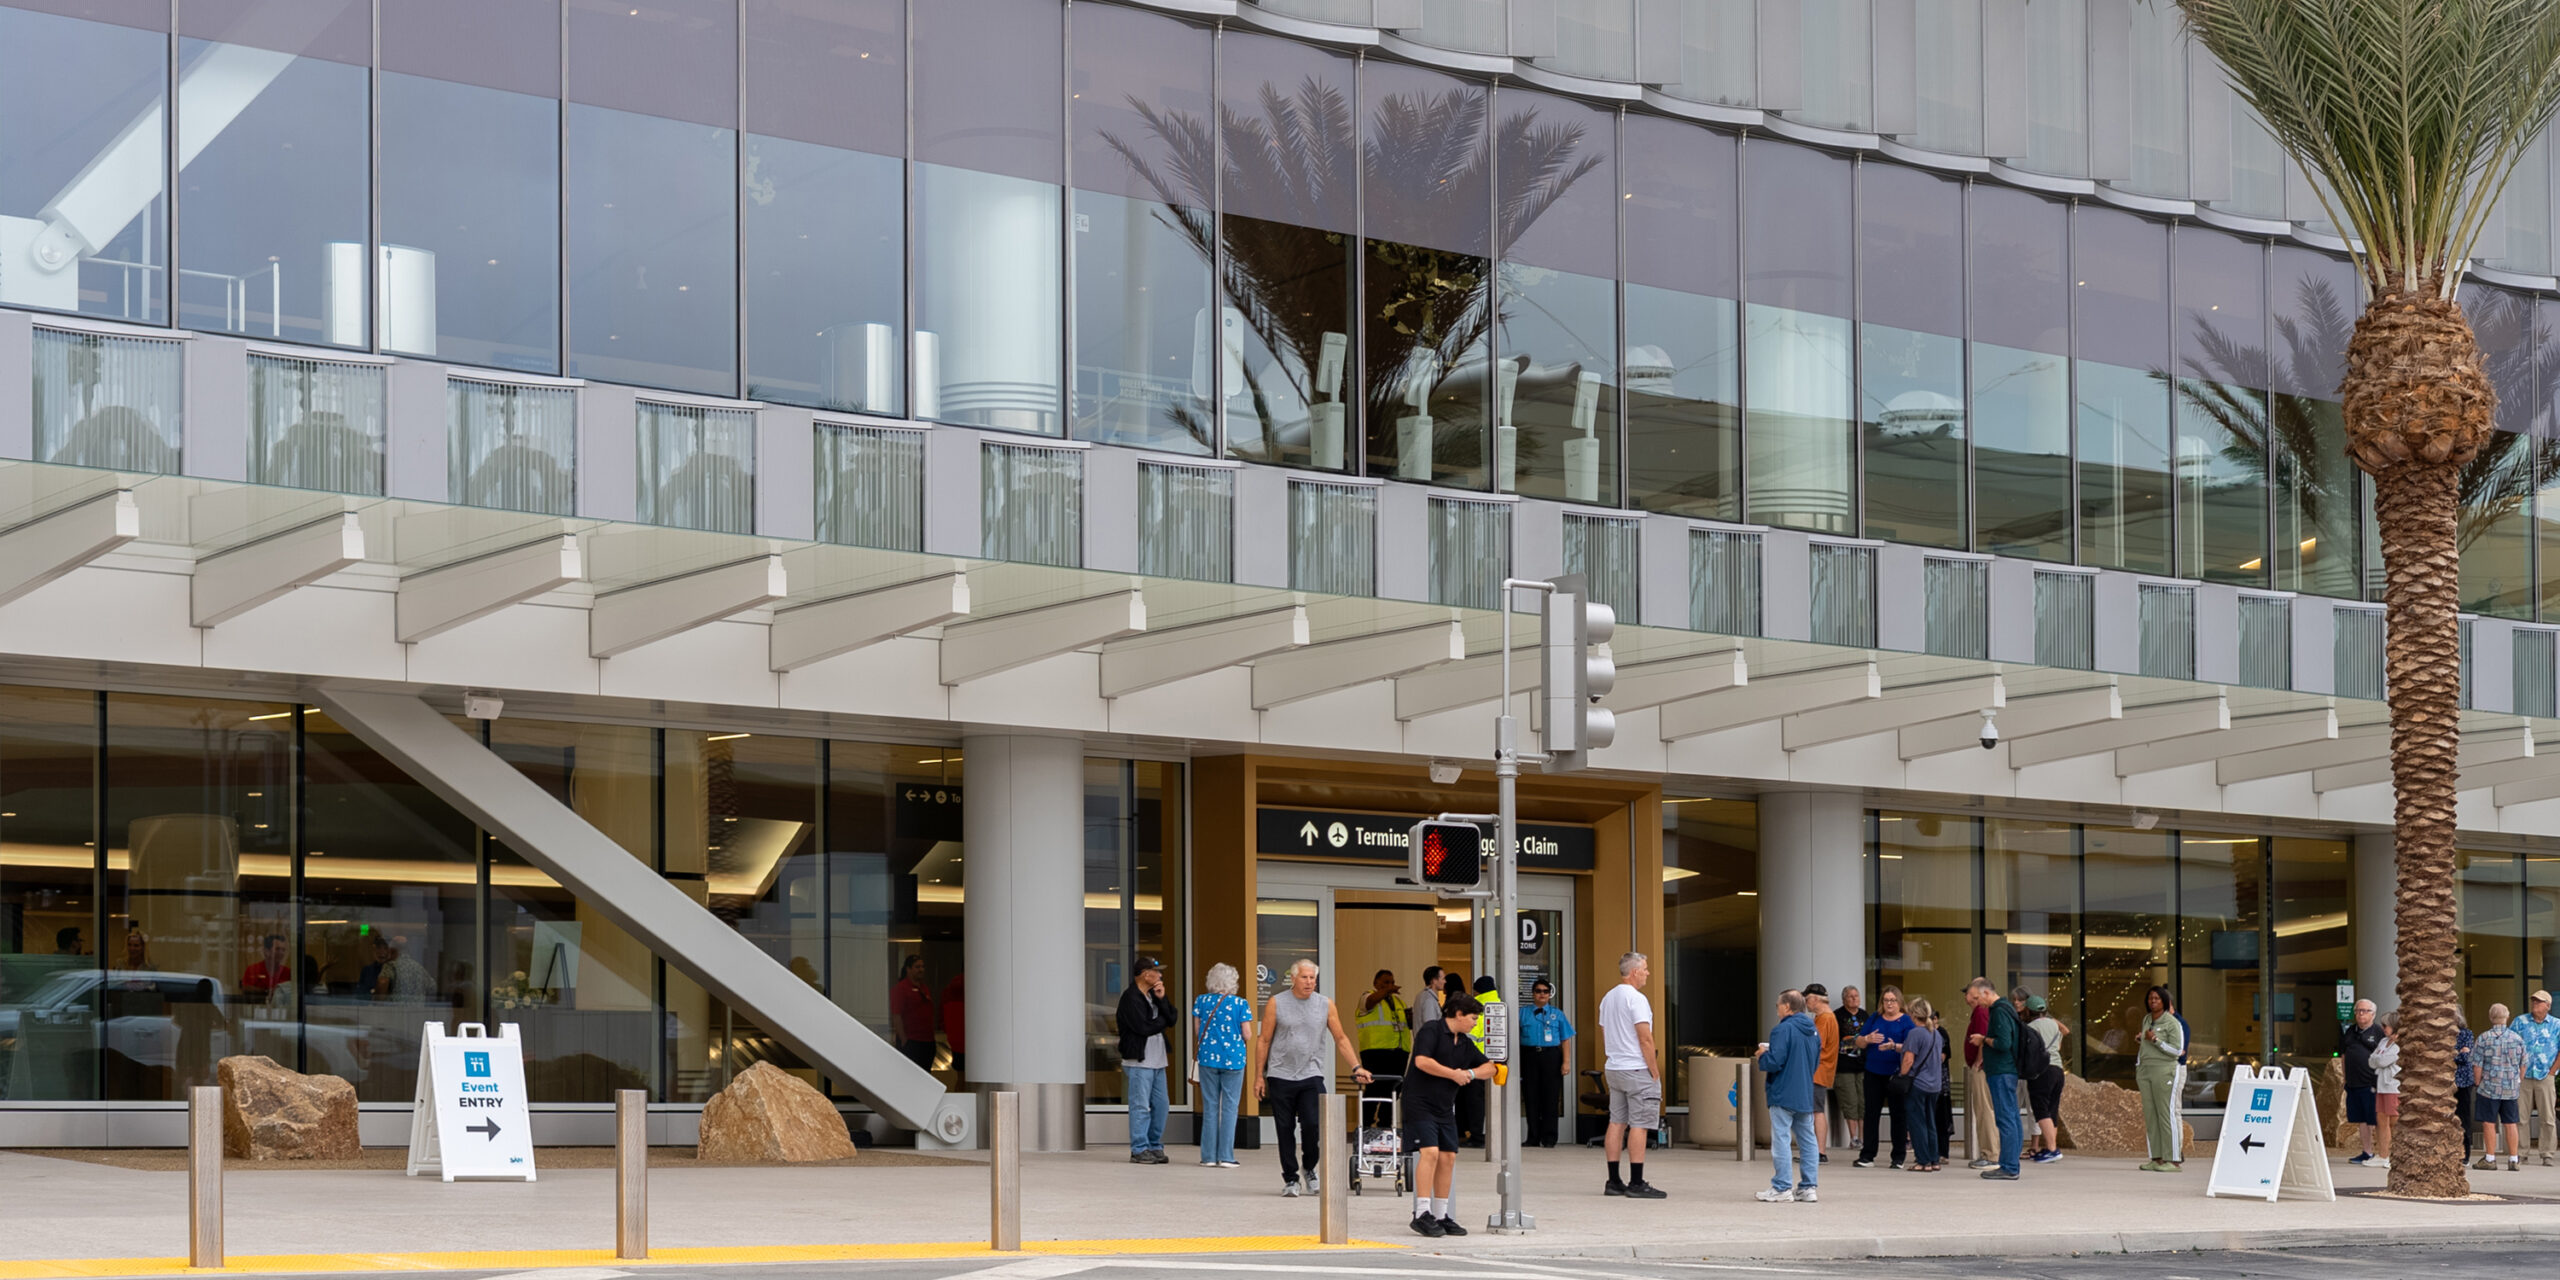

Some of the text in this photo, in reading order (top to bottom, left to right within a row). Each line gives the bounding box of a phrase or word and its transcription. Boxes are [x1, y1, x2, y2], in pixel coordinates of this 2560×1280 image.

[1355, 827, 1409, 848] Termina
[1523, 836, 1558, 855] Claim
[1522, 919, 1537, 941] D
[1520, 942, 1537, 950] ZONE
[2300, 998, 2313, 1022] 3
[471, 1062, 484, 1072] T1
[462, 1082, 499, 1092] Event
[459, 1097, 503, 1107] ENTRY
[2244, 1114, 2272, 1123] Event
